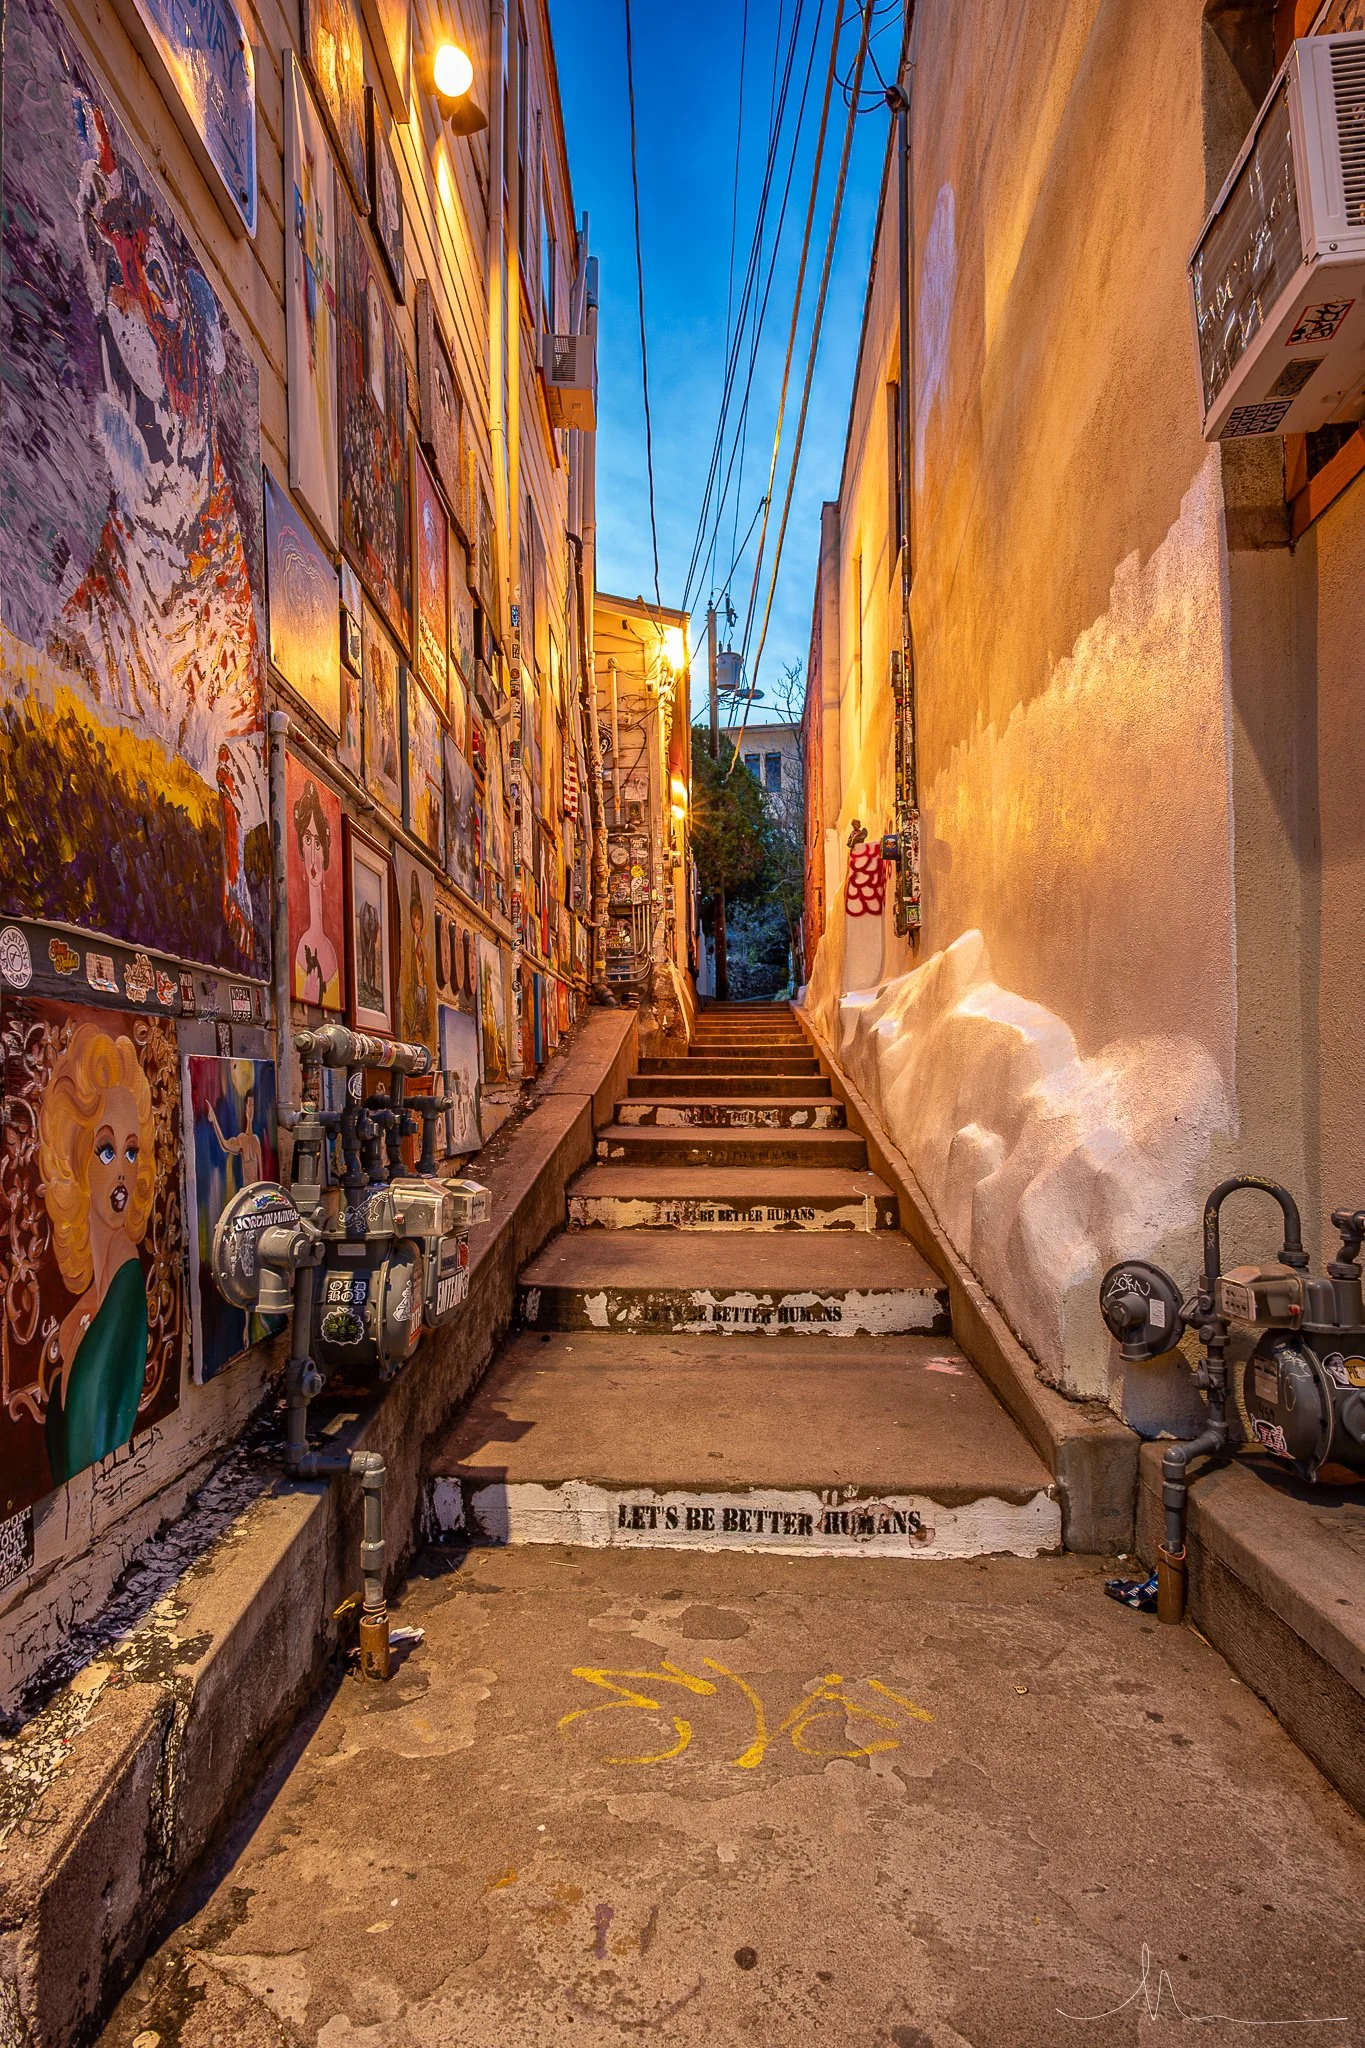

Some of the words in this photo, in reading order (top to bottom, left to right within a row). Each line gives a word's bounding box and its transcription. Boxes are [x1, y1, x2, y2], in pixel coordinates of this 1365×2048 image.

[231, 988, 250, 1001] NOPAL
[231, 1011, 252, 1022] HERE
[700, 1209, 715, 1223] BE
[718, 1209, 763, 1222] BETTER
[766, 1208, 815, 1221] HUMANS
[235, 1215, 273, 1231] JORDAN
[329, 1280, 367, 1292] OLD
[328, 1291, 366, 1305] BOY
[712, 1306, 772, 1323] BETTER
[617, 1503, 678, 1530] LET'S
[685, 1507, 715, 1531] BE
[722, 1507, 813, 1536] BETTER
[824, 1510, 921, 1535] HUMANS
